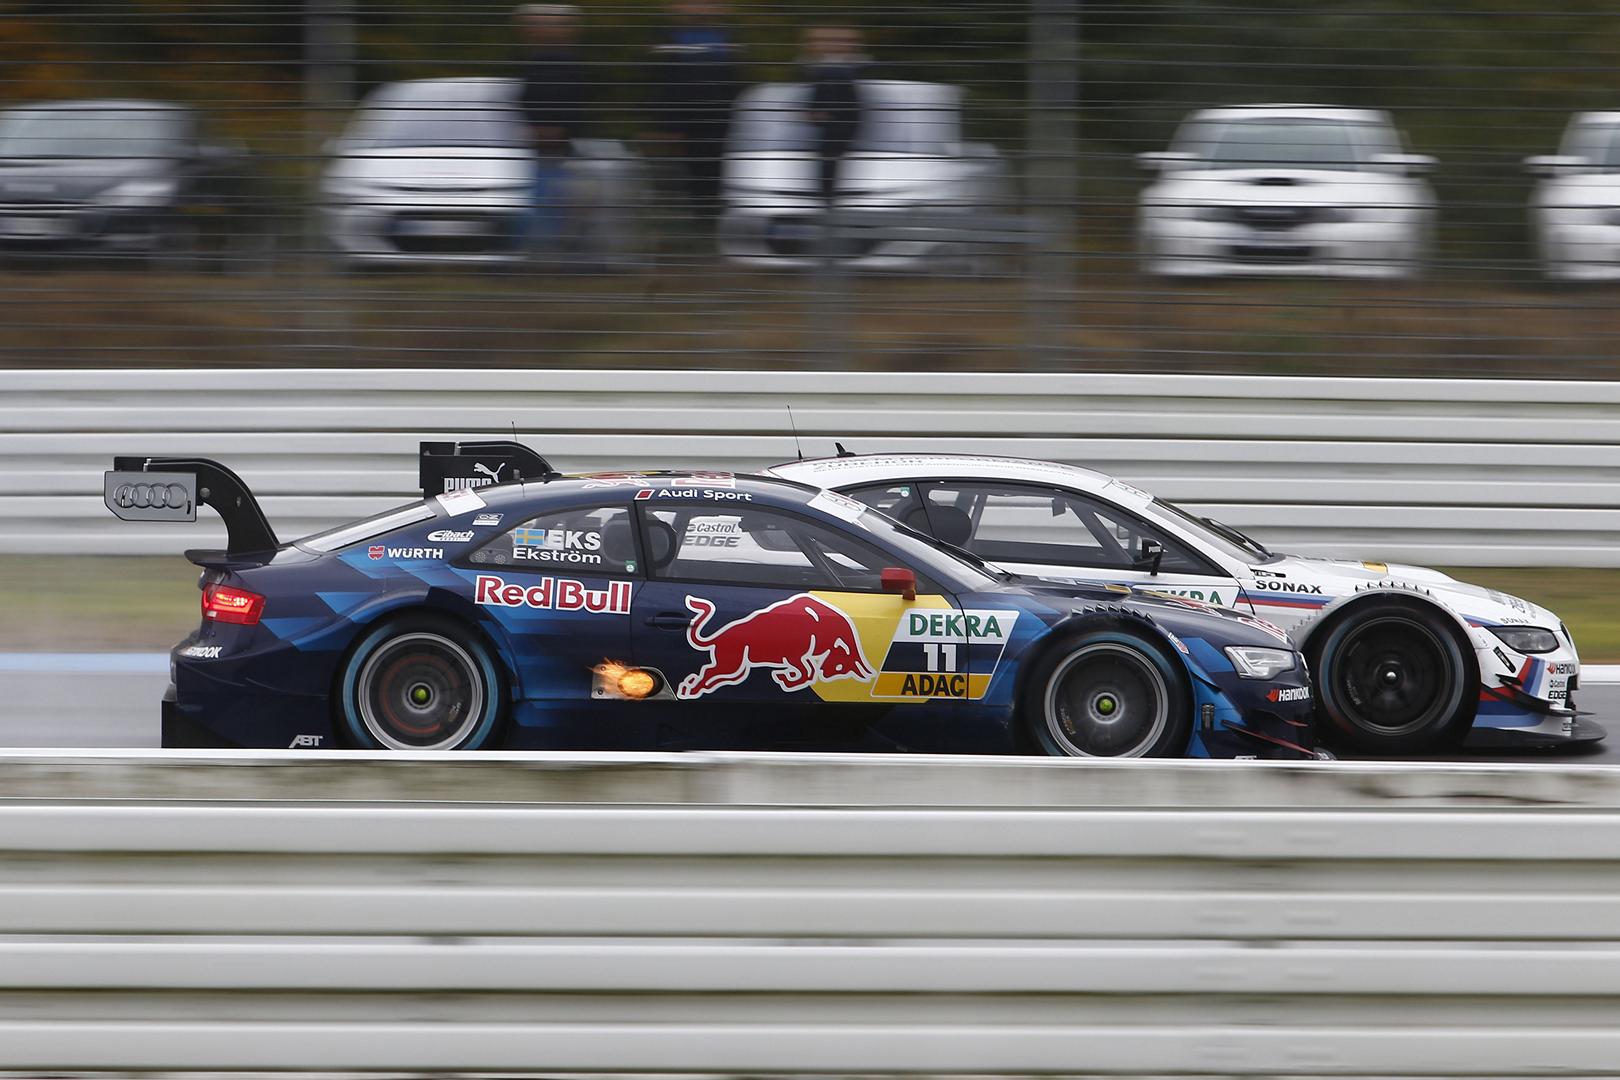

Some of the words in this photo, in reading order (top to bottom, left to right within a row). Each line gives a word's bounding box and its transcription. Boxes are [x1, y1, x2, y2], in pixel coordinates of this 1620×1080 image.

[658, 489, 698, 498] Audi
[703, 490, 752, 501] Sport
[696, 523, 736, 533] Castrol
[547, 530, 601, 550] EKS
[683, 536, 741, 547] EDGE
[512, 547, 602, 564] Ekström
[475, 575, 554, 609] Red
[556, 579, 632, 614] Bull
[1255, 580, 1322, 594] SONAX
[910, 613, 1003, 638] DEKRA
[924, 644, 957, 672] 11
[901, 674, 965, 697] ADAC
[288, 734, 323, 749] ABT
